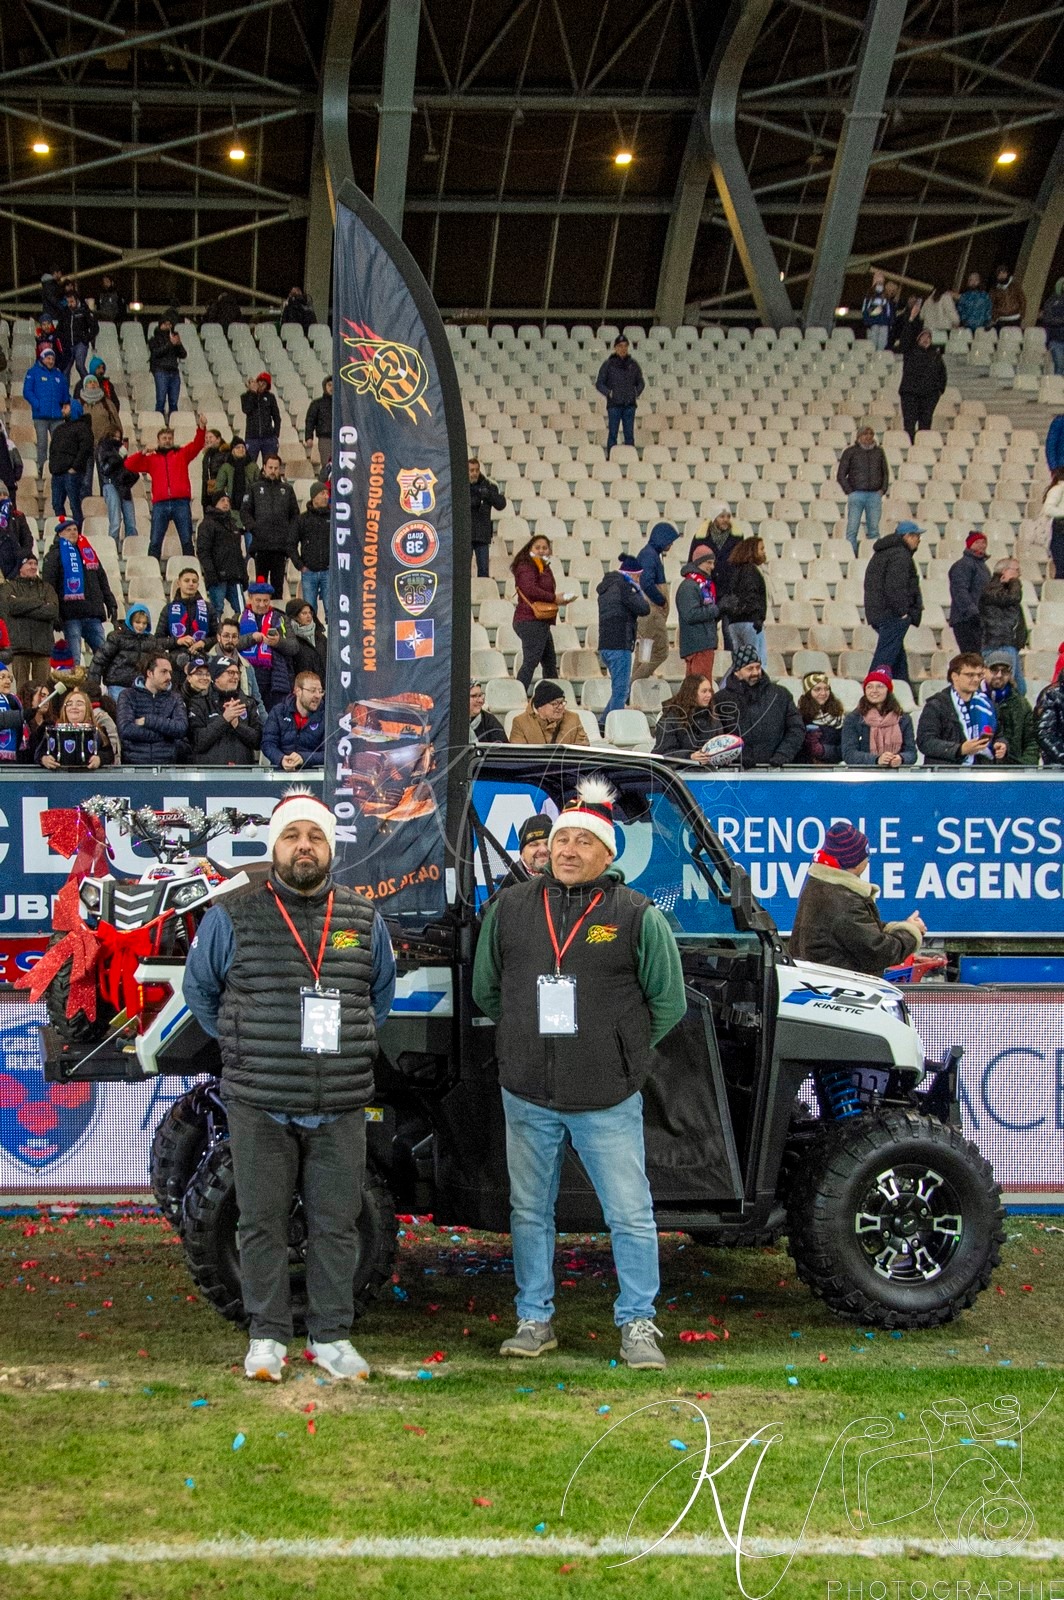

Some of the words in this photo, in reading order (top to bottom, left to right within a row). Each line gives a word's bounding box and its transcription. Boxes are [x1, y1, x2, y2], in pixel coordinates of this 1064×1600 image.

[69, 552, 79, 573] BLEU
[683, 816, 901, 854] RENOLE
[936, 816, 1063, 855] SEYSS
[915, 862, 1064, 900] AGENC
[812, 1002, 865, 1016] KINETIC
